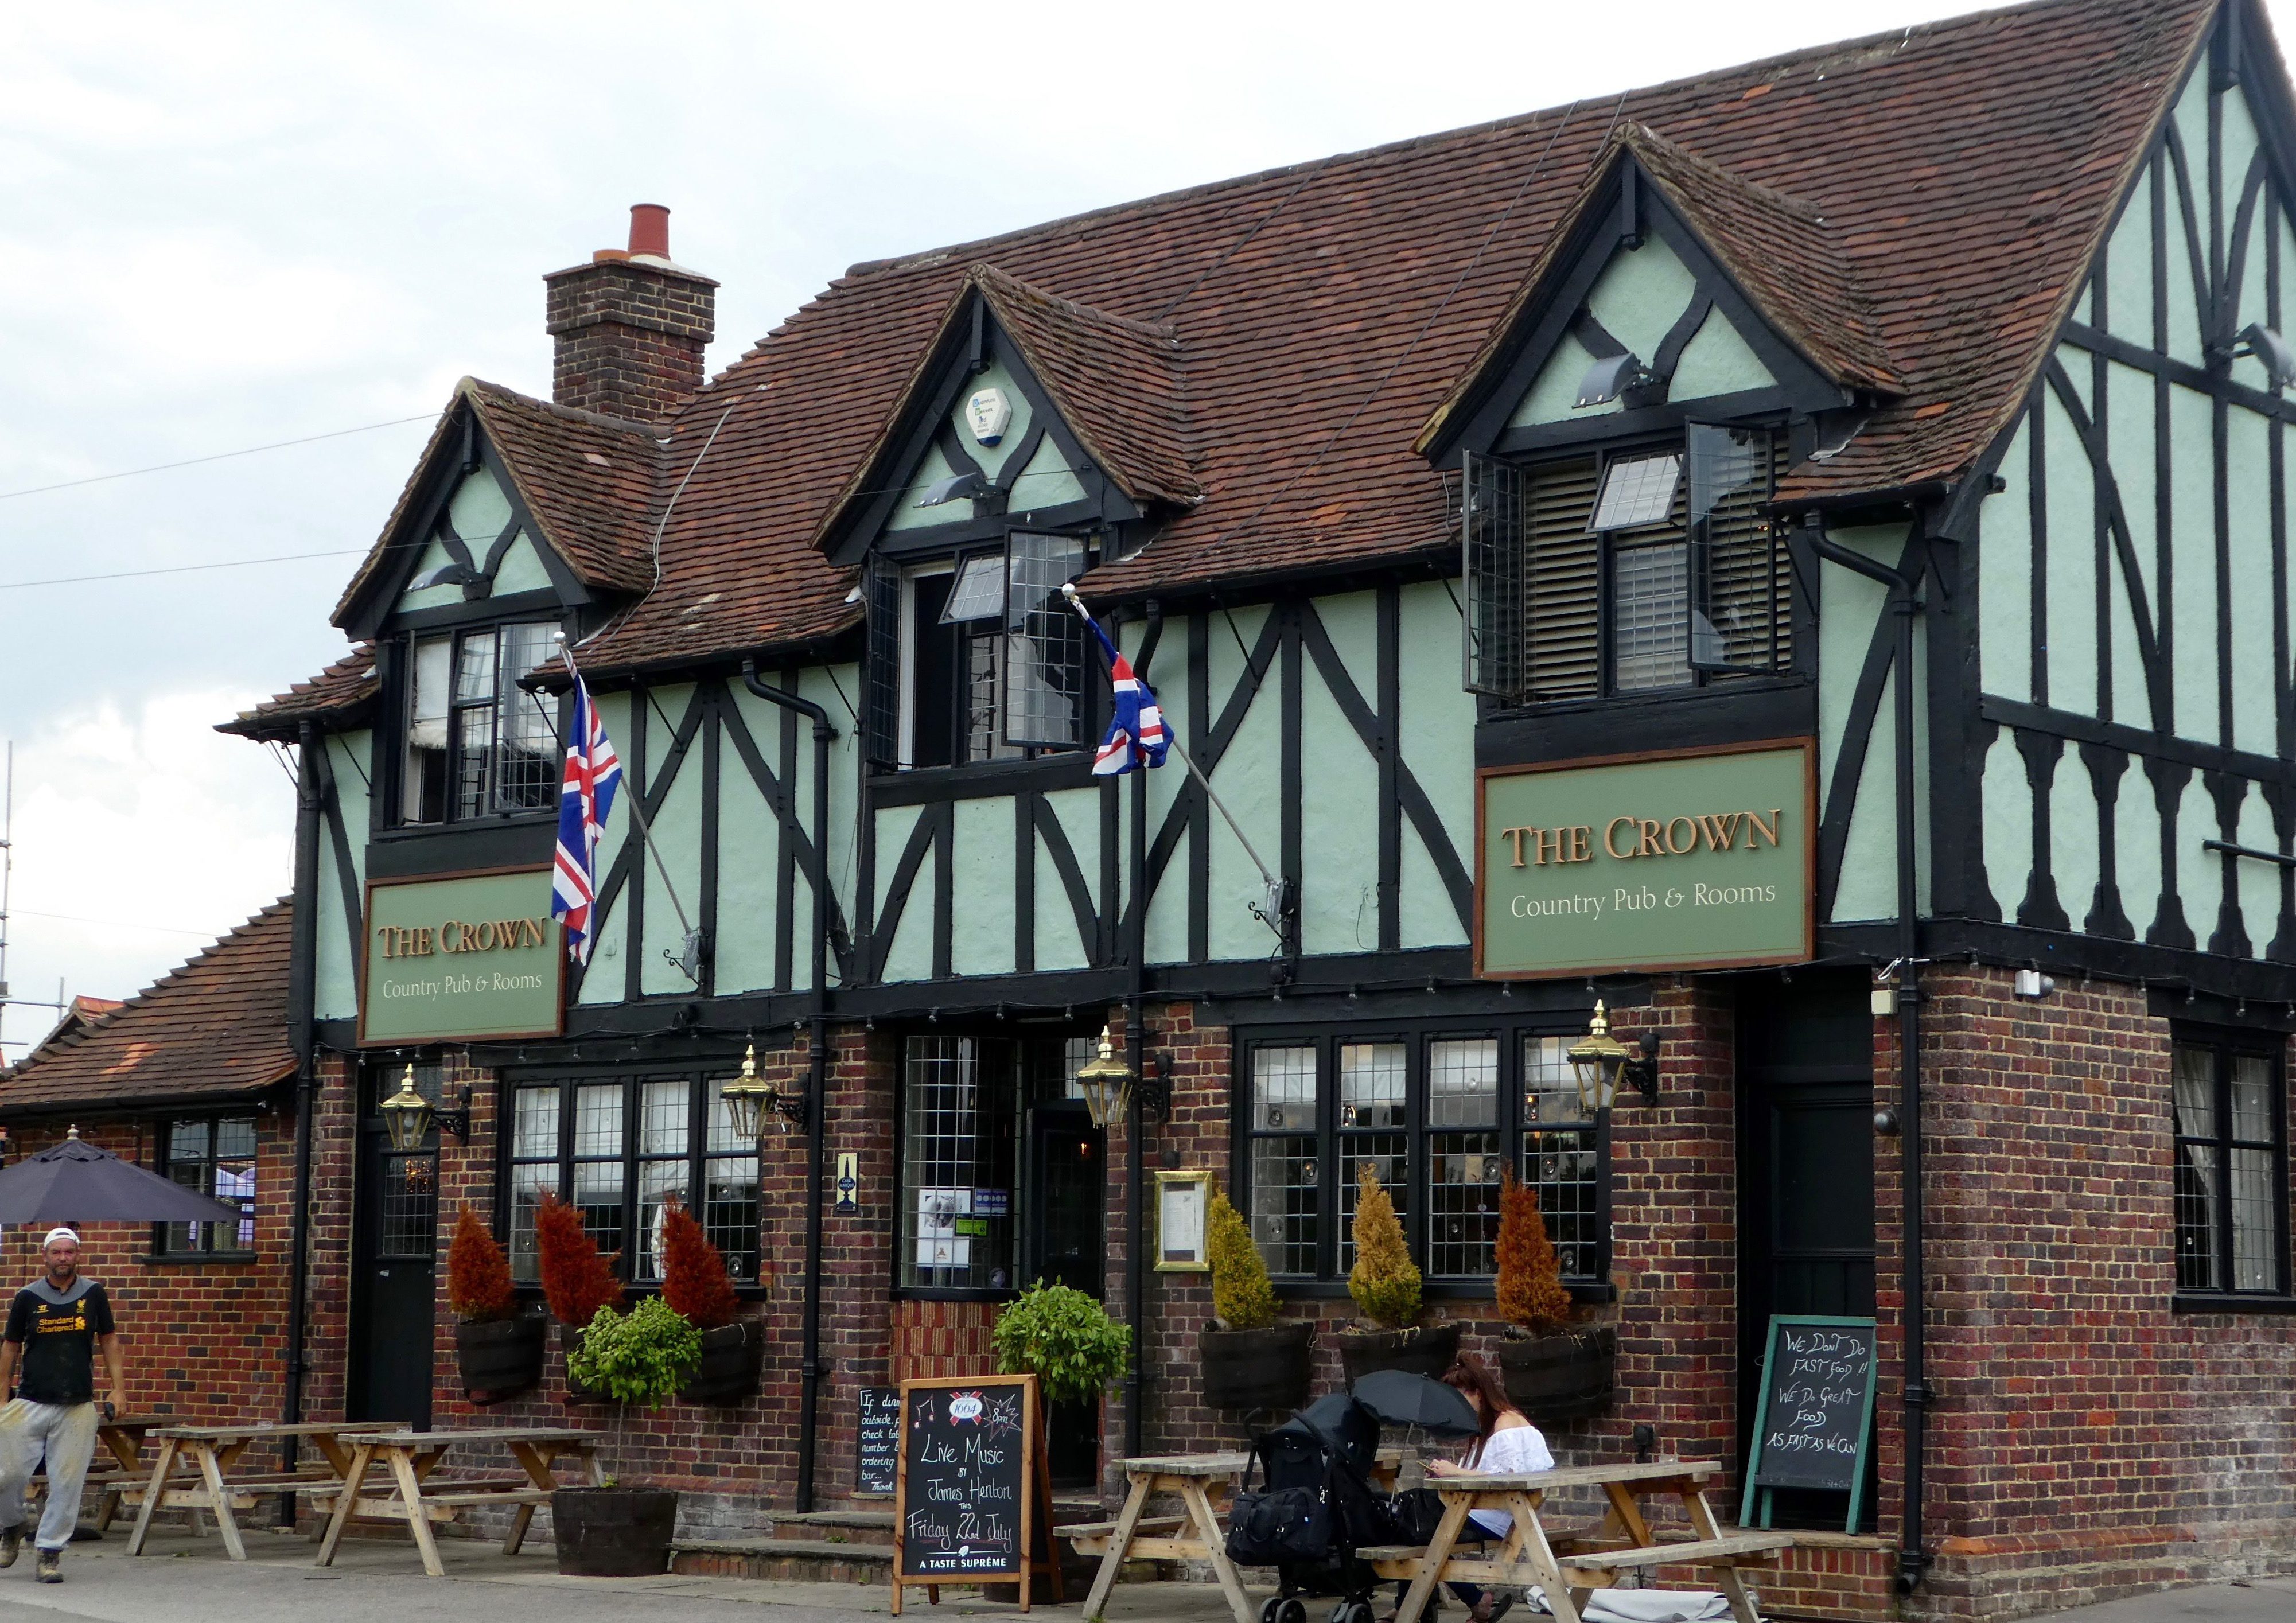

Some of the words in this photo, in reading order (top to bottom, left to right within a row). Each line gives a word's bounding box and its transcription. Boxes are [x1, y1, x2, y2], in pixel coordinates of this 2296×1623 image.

[1501, 826, 1593, 867] THE
[1604, 809, 1781, 858] CROWN
[1511, 895, 1605, 920] Country
[1614, 886, 1656, 910] Pub
[1665, 888, 1685, 908] &
[1694, 883, 1775, 906] Rooms
[378, 925, 433, 958] THE
[440, 917, 547, 953] CROWN
[383, 980, 440, 1001] Country
[445, 974, 470, 993] Pub
[475, 976, 488, 991] &
[493, 972, 542, 990] Rooms
[37, 1324, 73, 1333] Chartered
[39, 1316, 74, 1325] Standard
[1789, 1359, 1831, 1376] FAST
[863, 1394, 874, 1415] If
[1779, 1381, 1800, 1403] WE
[1820, 1387, 1861, 1408] GREAT
[992, 1408, 1008, 1424] 8pm
[862, 1429, 883, 1439] check
[889, 1429, 900, 1439] tab
[1766, 1432, 1784, 1447] AS
[1781, 1434, 1813, 1451] FAST
[1809, 1437, 1823, 1452] AS
[862, 1444, 890, 1452] number
[921, 1434, 958, 1462] Live
[965, 1433, 1004, 1473] Music
[862, 1458, 895, 1472] ordering
[871, 1481, 893, 1491] Thank
[927, 1478, 963, 1501] James
[969, 1476, 1012, 1504] Henton
[907, 1508, 951, 1550] Friday
[956, 1512, 979, 1539] 22nd
[985, 1513, 1013, 1553] July
[919, 1560, 927, 1568] A
[929, 1559, 956, 1568] TASTE
[960, 1557, 1006, 1568] SUPRÊME
